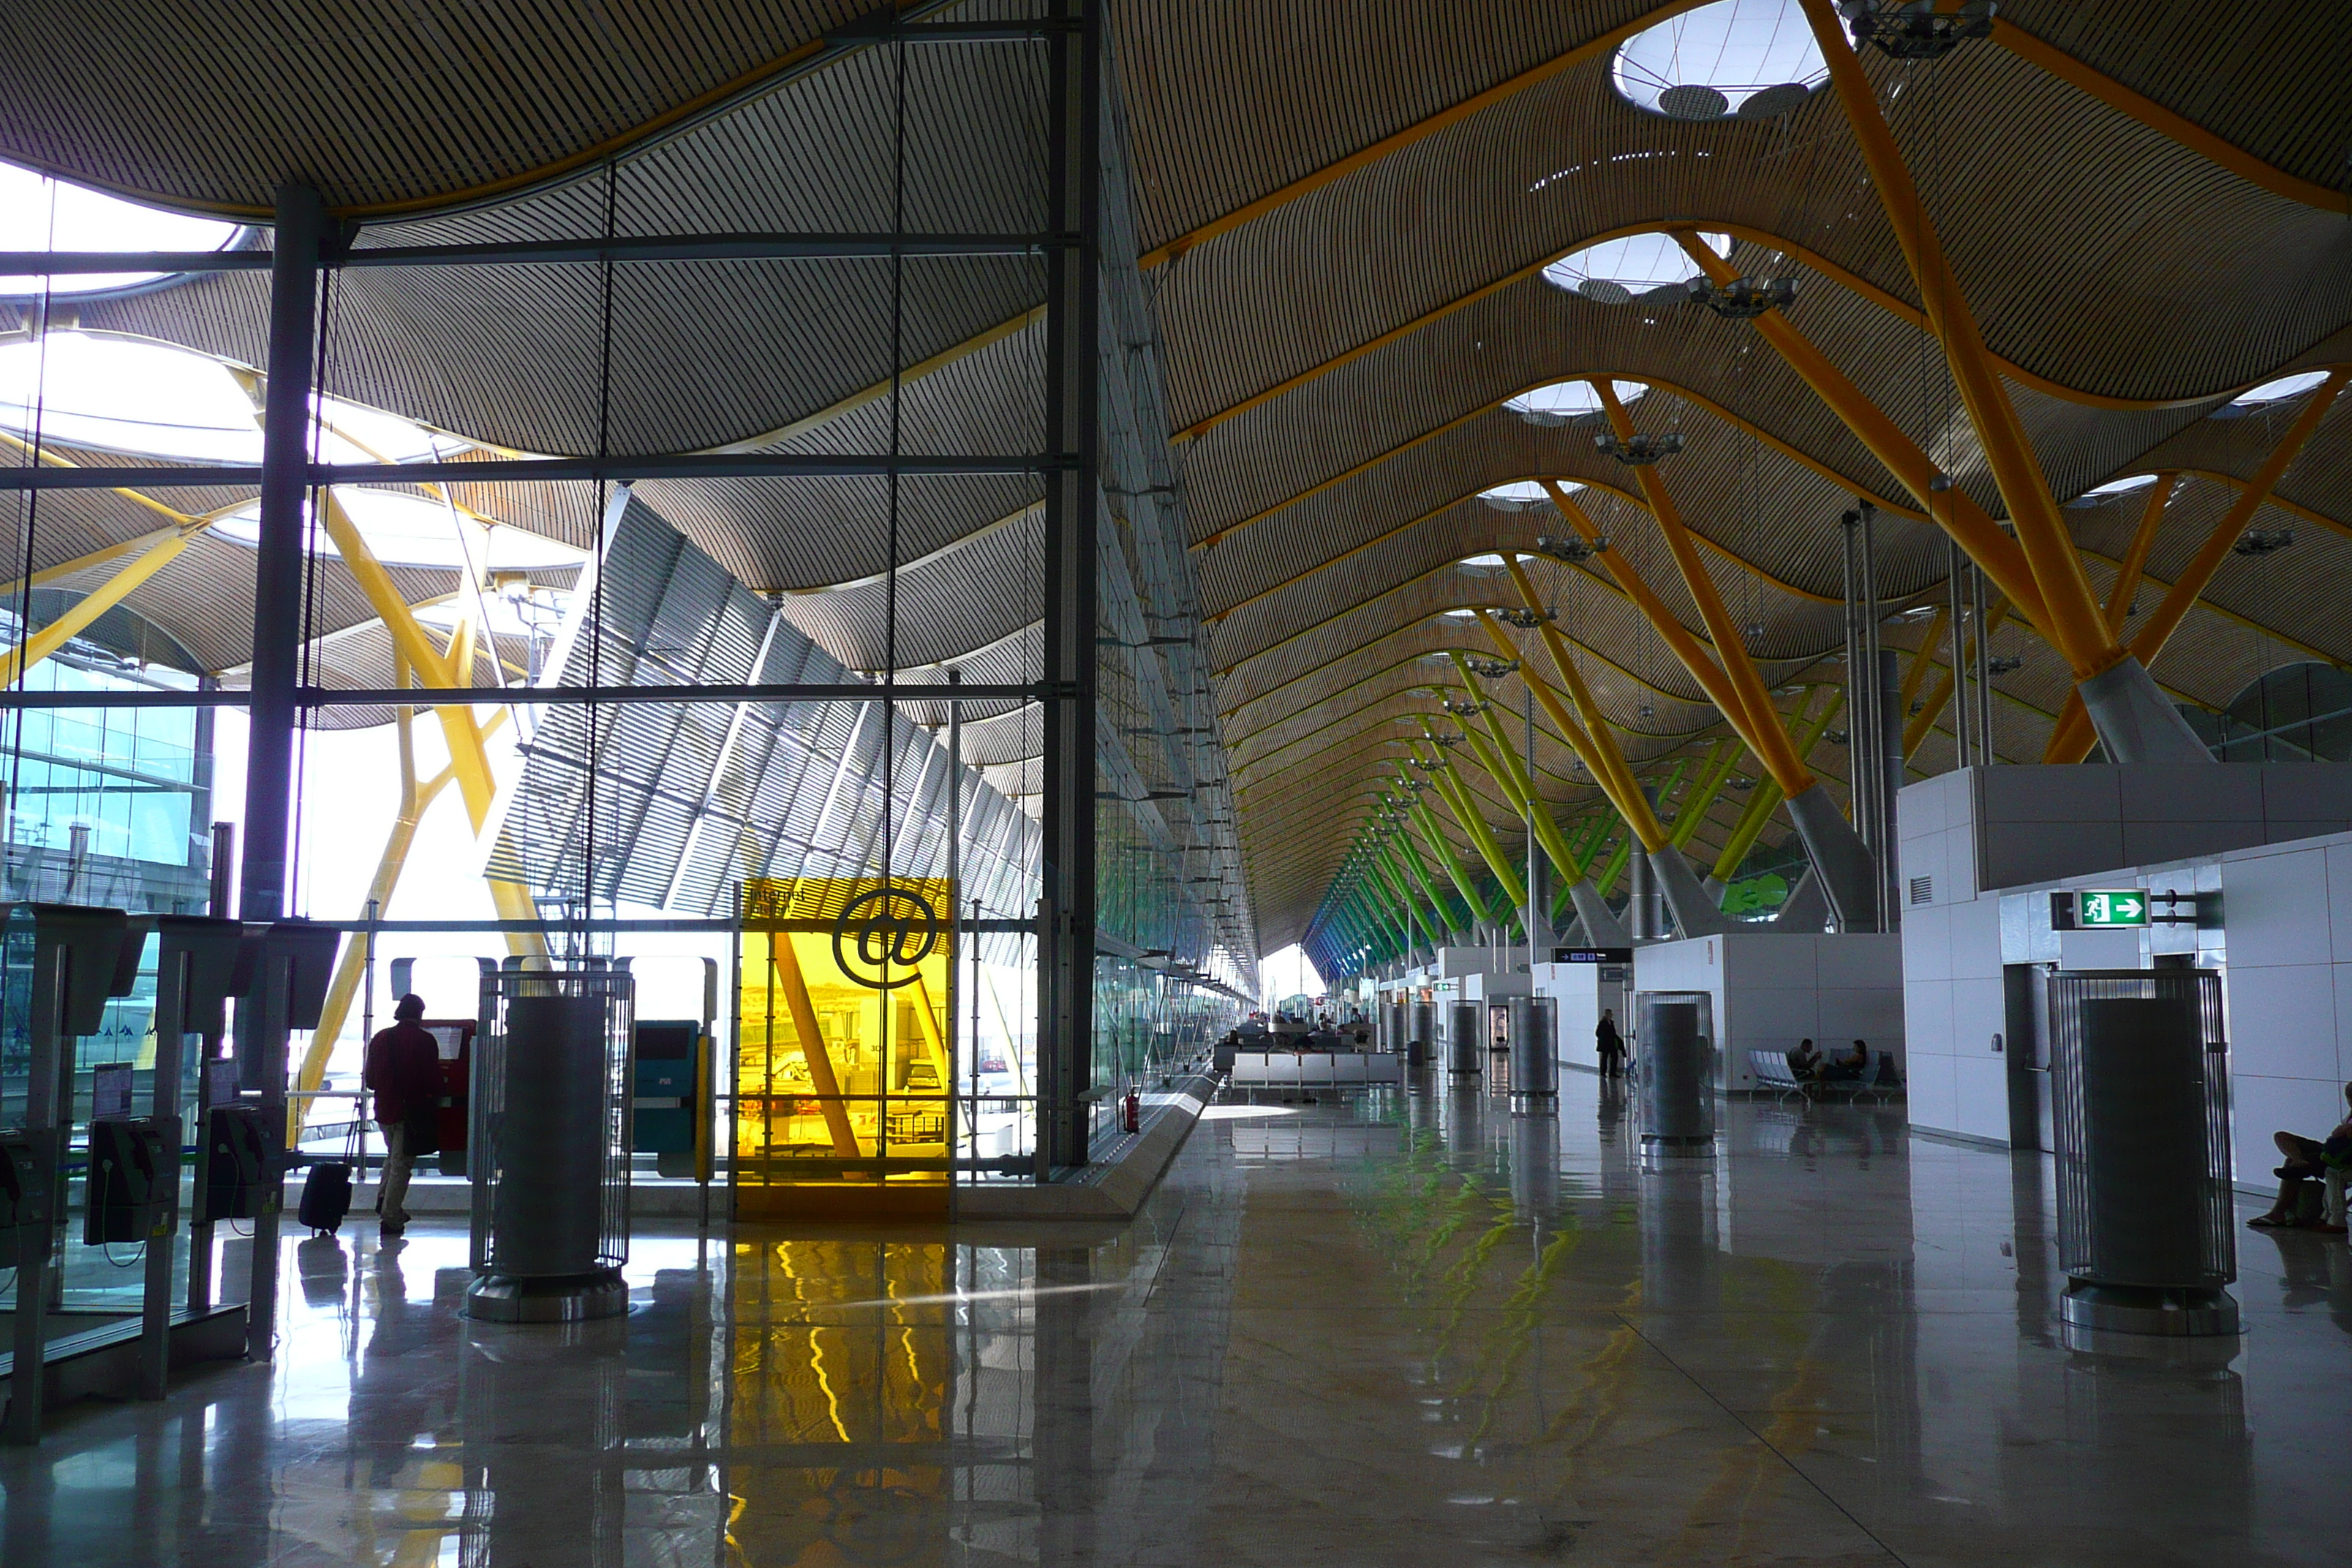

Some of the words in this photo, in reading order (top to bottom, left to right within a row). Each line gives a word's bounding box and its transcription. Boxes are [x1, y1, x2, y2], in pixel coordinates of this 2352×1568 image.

[750, 888, 804, 901] Internet
[750, 903, 791, 914] Intnet
[832, 889, 937, 990] @
